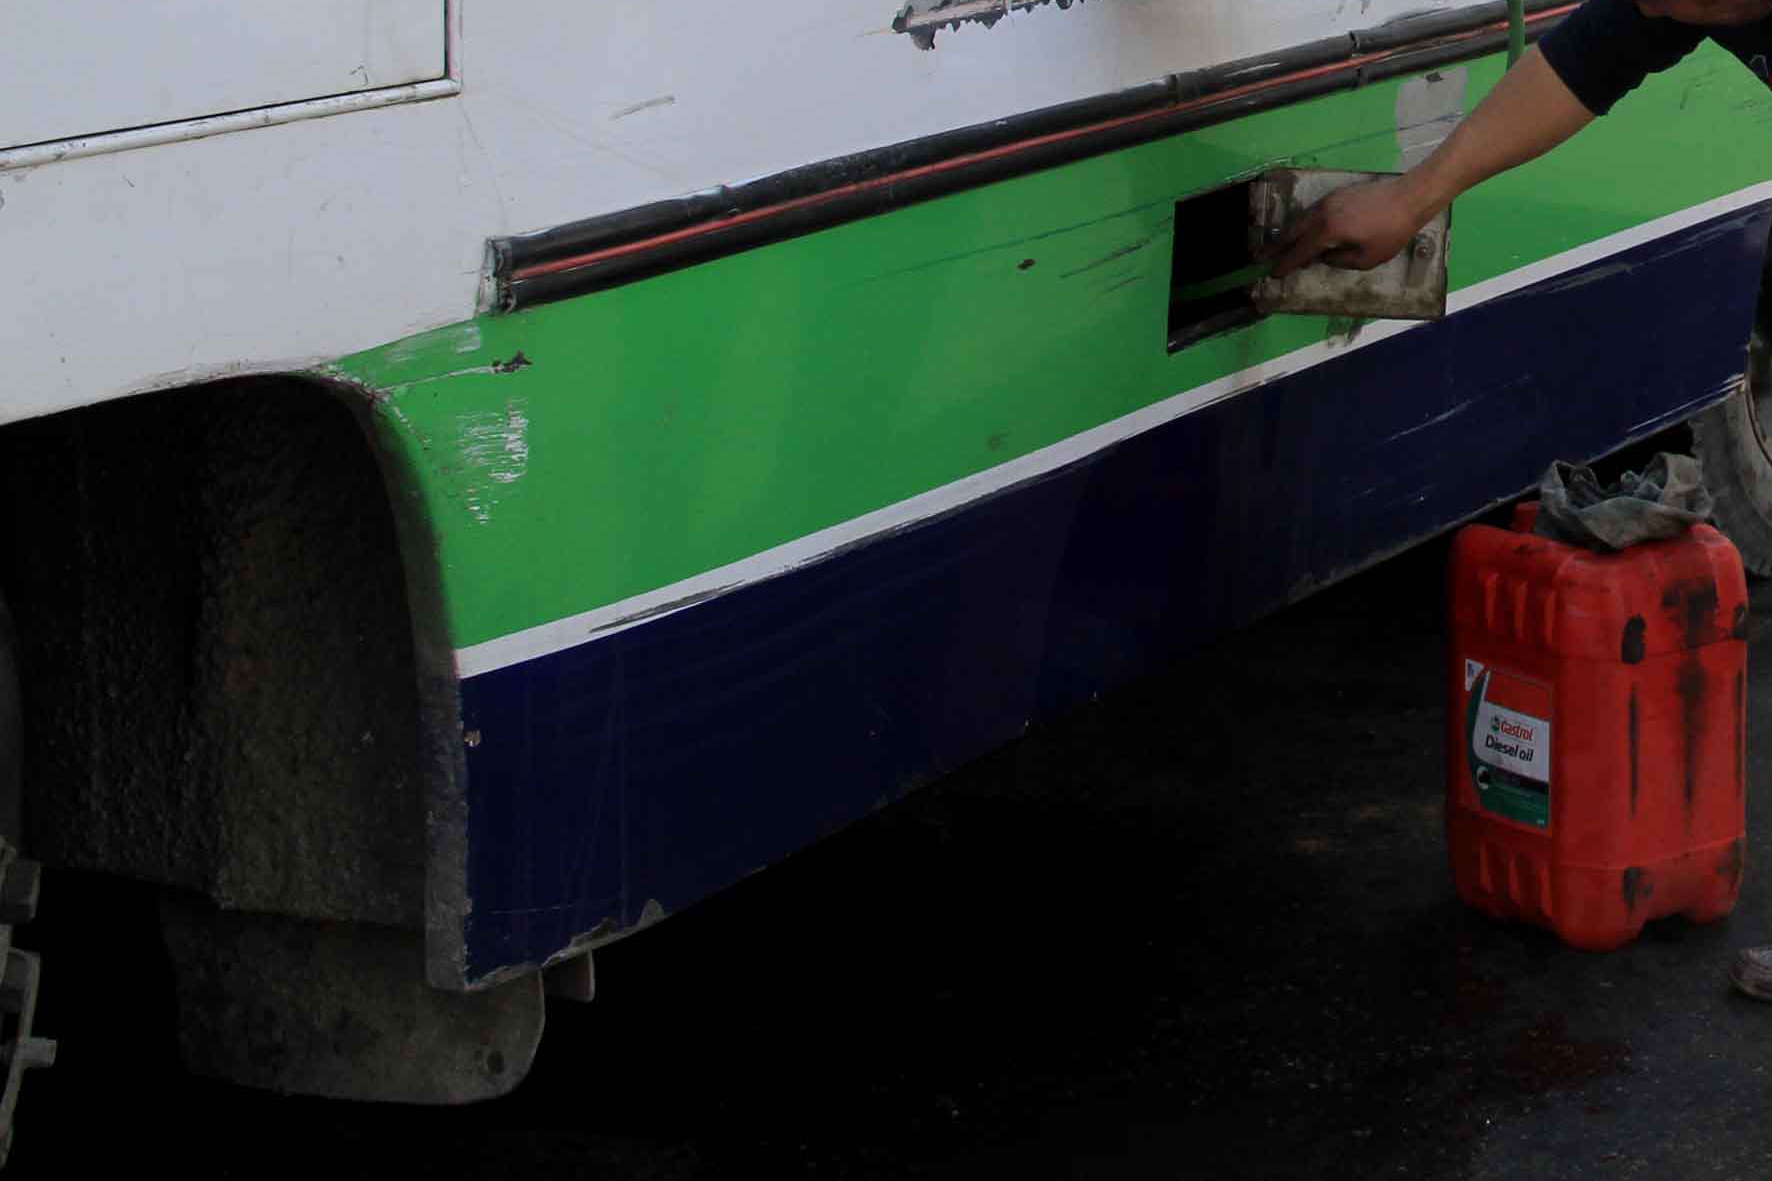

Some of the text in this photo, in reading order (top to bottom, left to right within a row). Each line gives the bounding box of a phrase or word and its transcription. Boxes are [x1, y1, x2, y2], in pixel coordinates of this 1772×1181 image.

[1501, 720, 1533, 742] Castrol
[1485, 733, 1534, 763] Diesel oil
